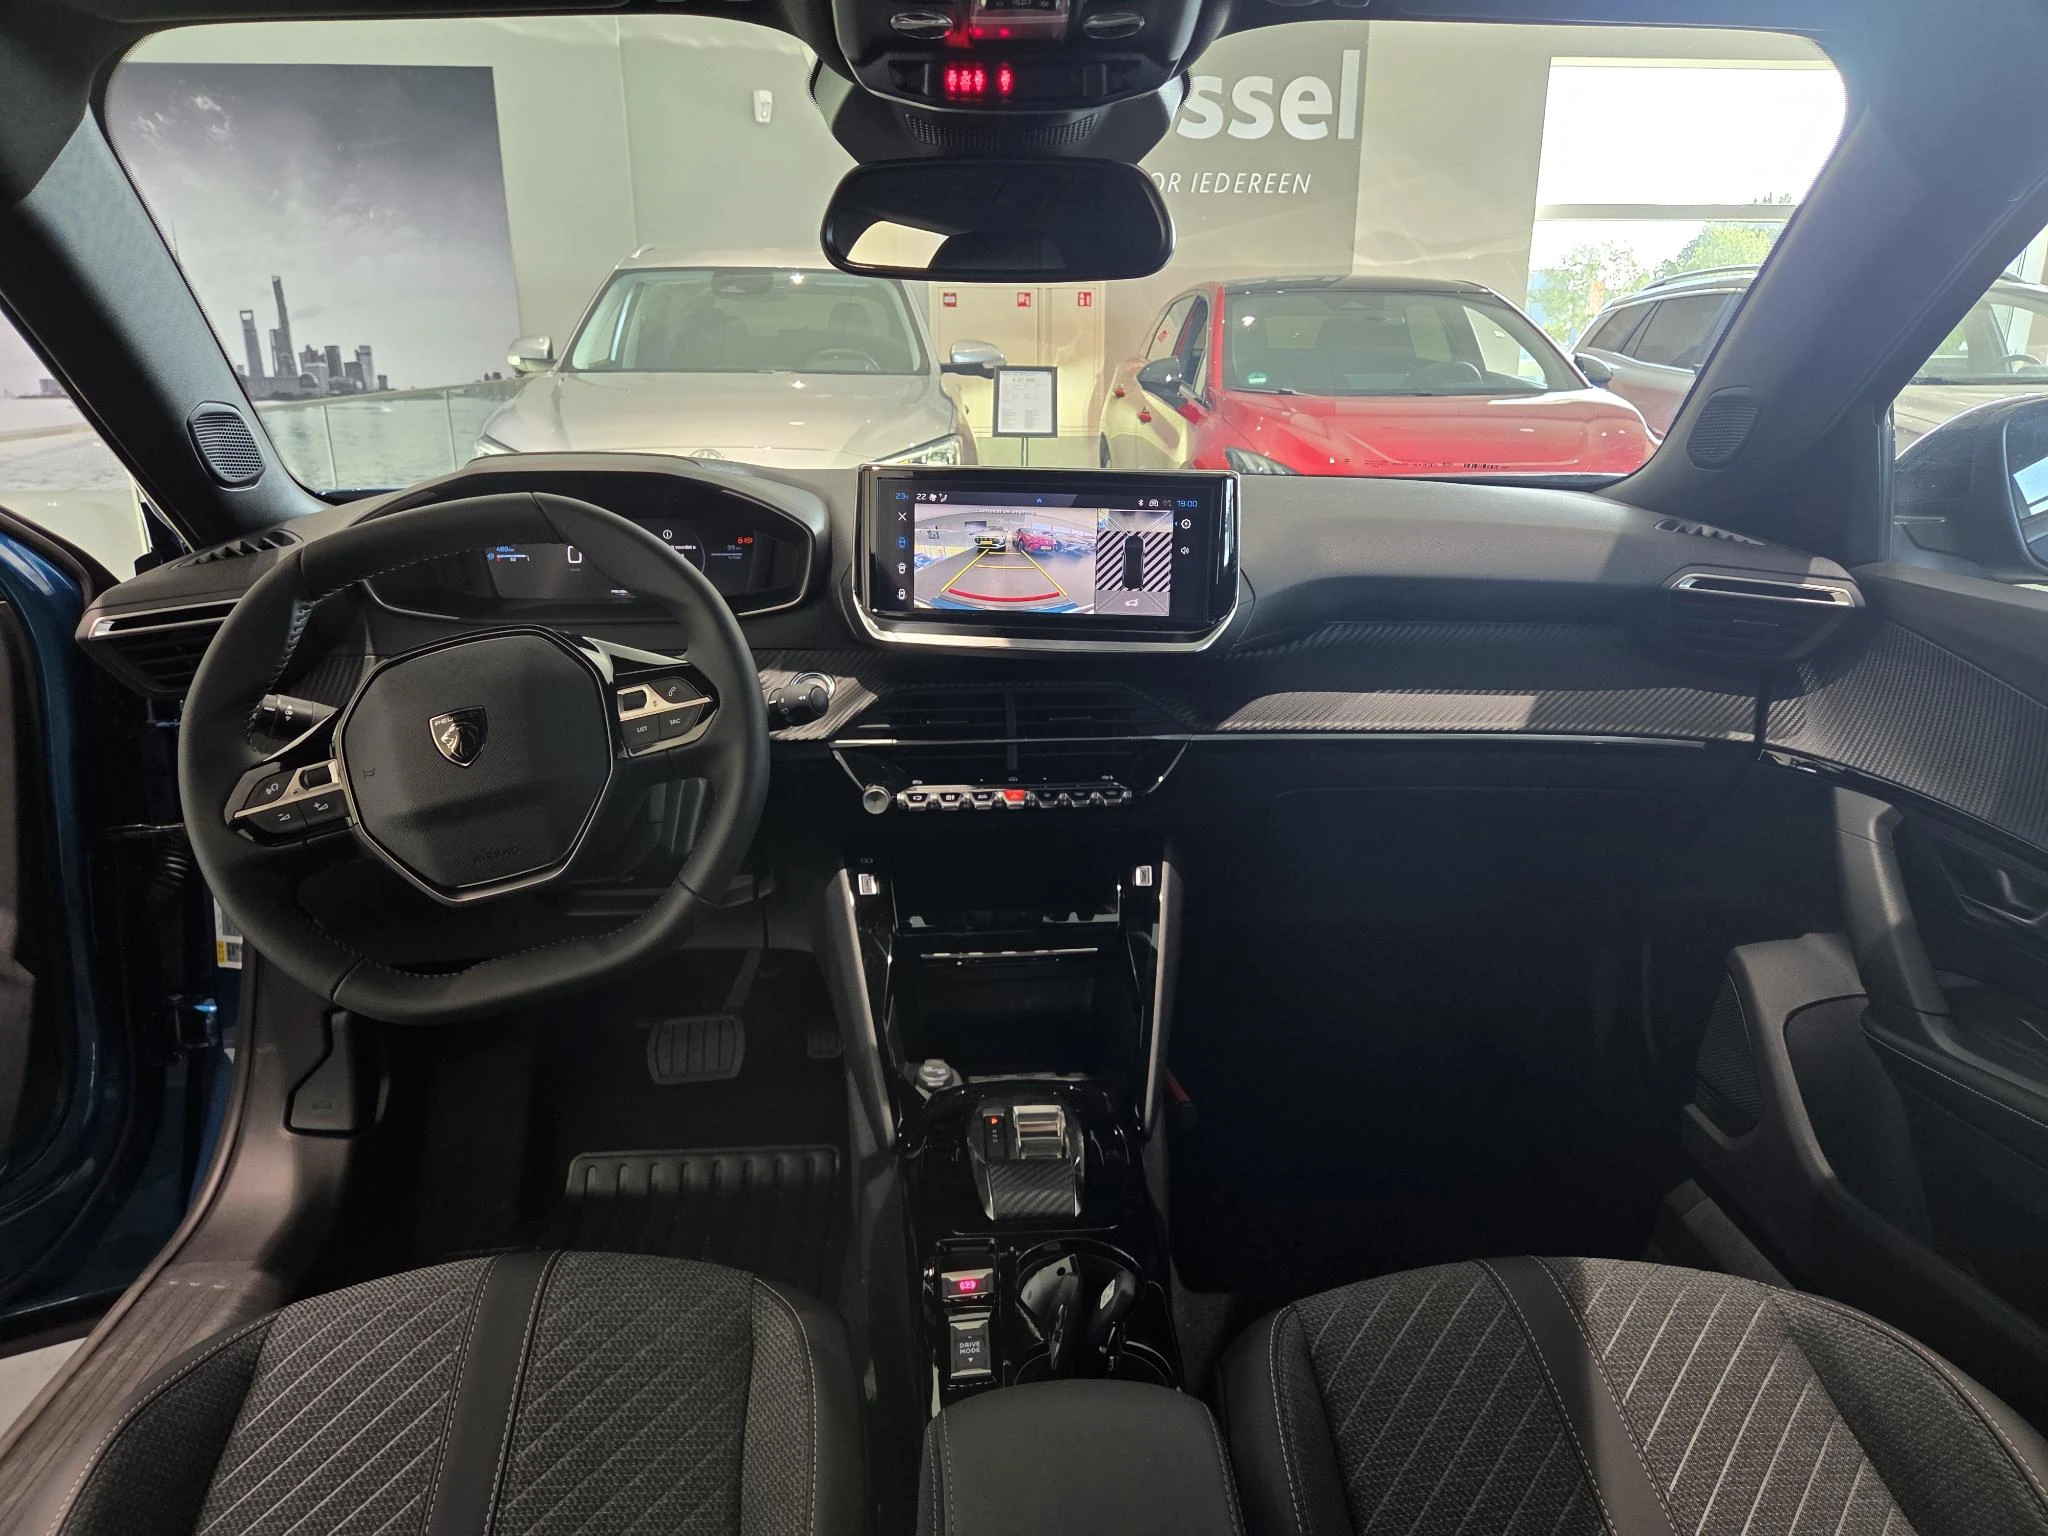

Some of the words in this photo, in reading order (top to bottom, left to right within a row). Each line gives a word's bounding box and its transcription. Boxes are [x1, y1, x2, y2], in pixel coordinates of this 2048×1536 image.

[1190, 172, 1312, 194] IEDEREEN
[669, 717, 681, 726] SRC
[636, 725, 648, 733] LIST
[959, 1340, 981, 1349] DRIVE
[959, 1347, 981, 1355] MODE
